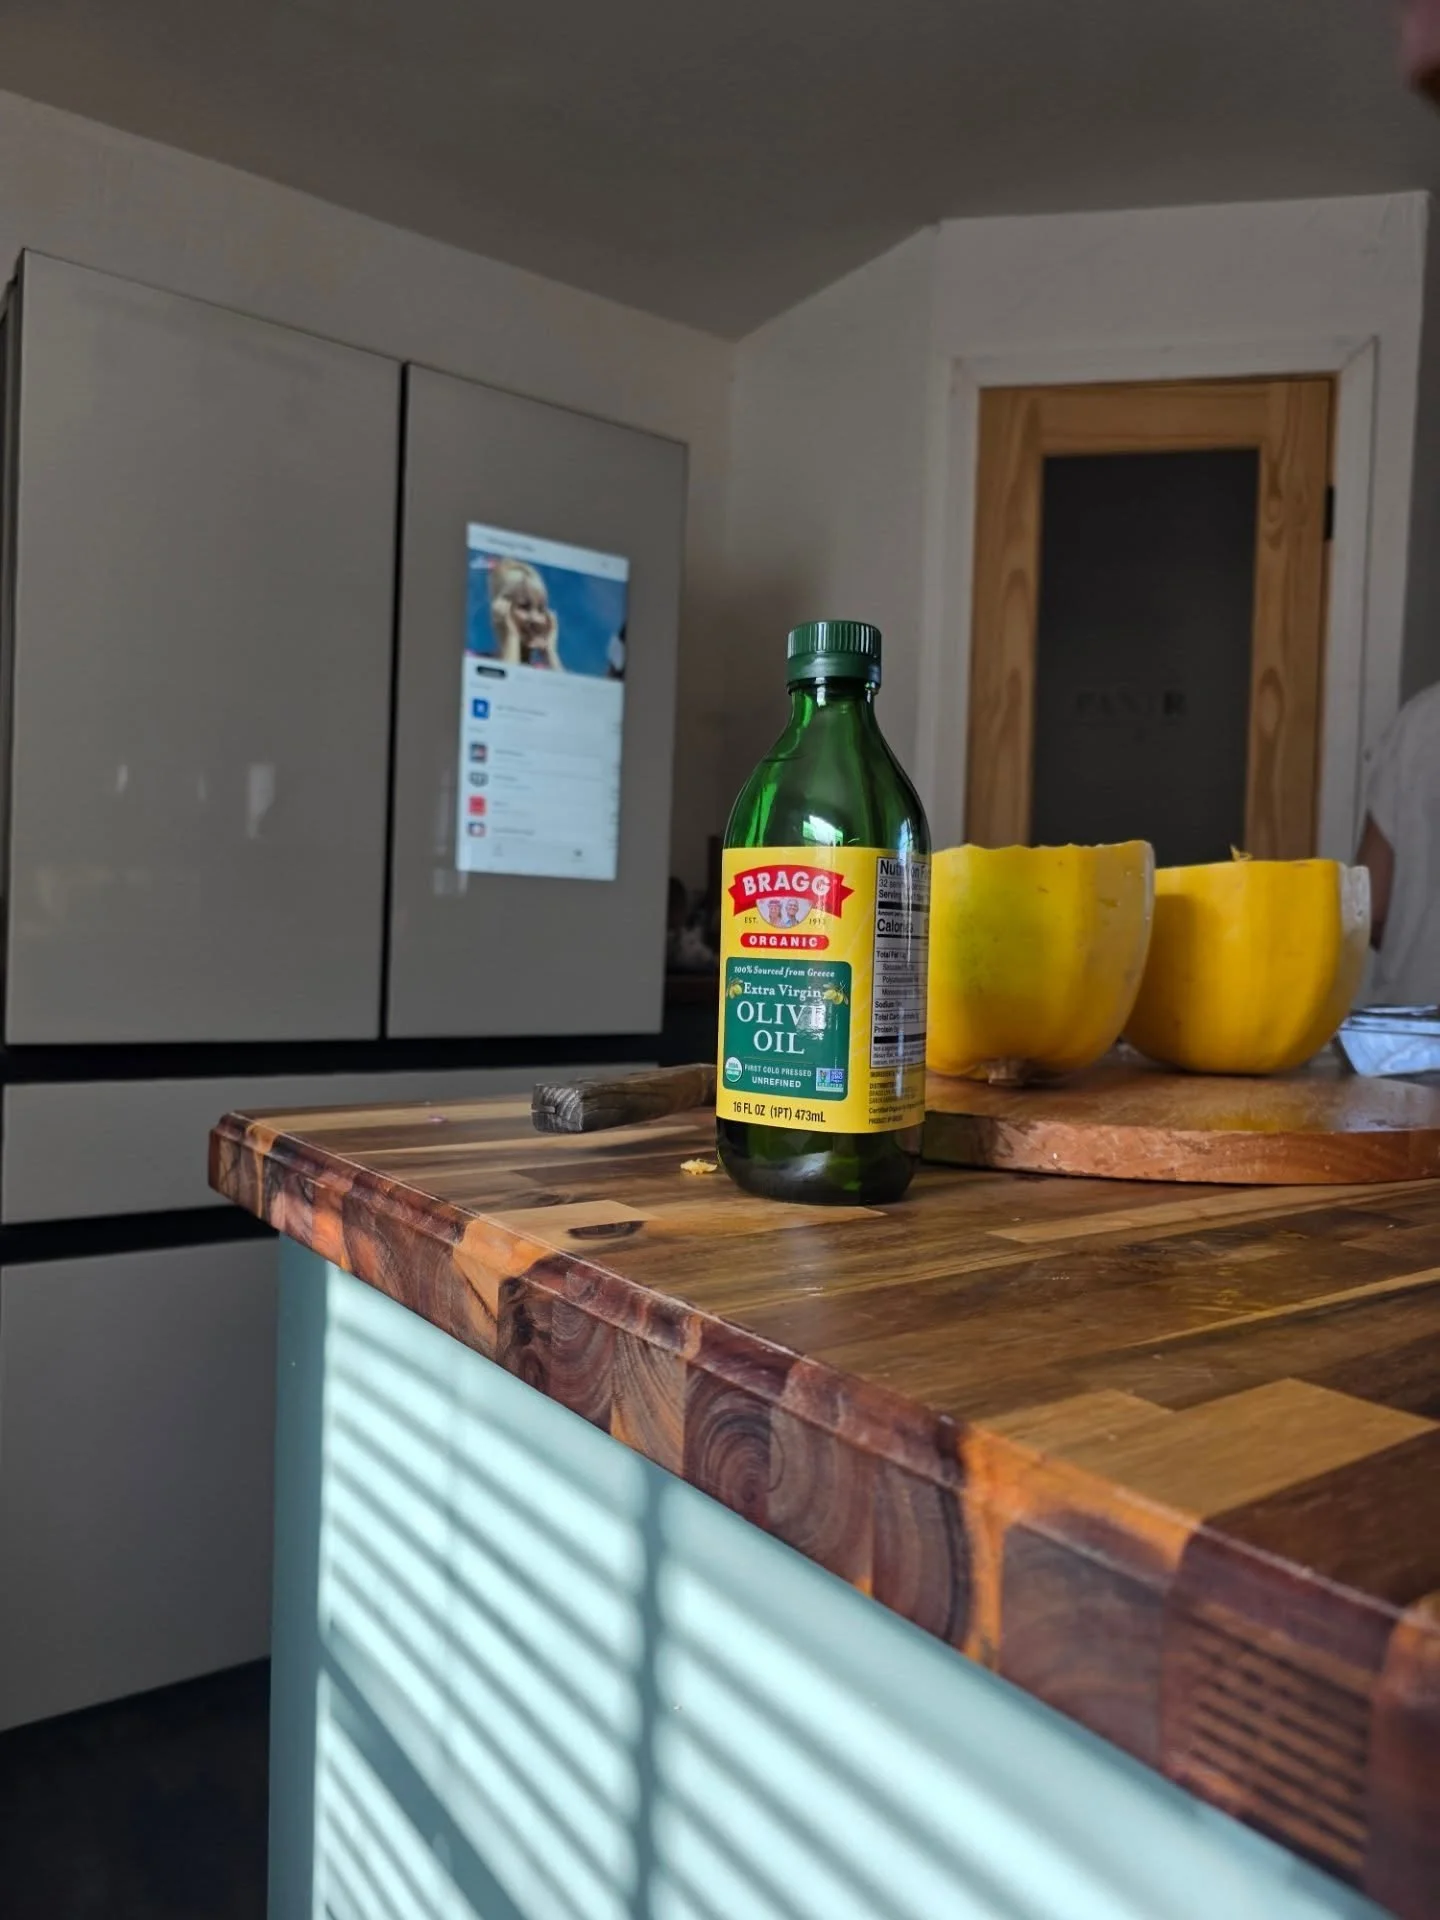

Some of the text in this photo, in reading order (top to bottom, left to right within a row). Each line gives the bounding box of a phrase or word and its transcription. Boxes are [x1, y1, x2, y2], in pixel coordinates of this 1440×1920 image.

[742, 871, 830, 896] BRAGG
[744, 917, 758, 925] EST.
[749, 936, 818, 948] ORGANIC
[734, 965, 835, 979] 100% Sourced from Greece
[744, 982, 822, 1001] Extra Virgin
[736, 1001, 826, 1029] OLIVE
[753, 1029, 805, 1055] OIL
[744, 1064, 812, 1077] FIRST COLD PRESSED
[752, 1076, 802, 1088] UNREFINED
[733, 1101, 826, 1123] 16 FL OZ (1PT) 473mL
